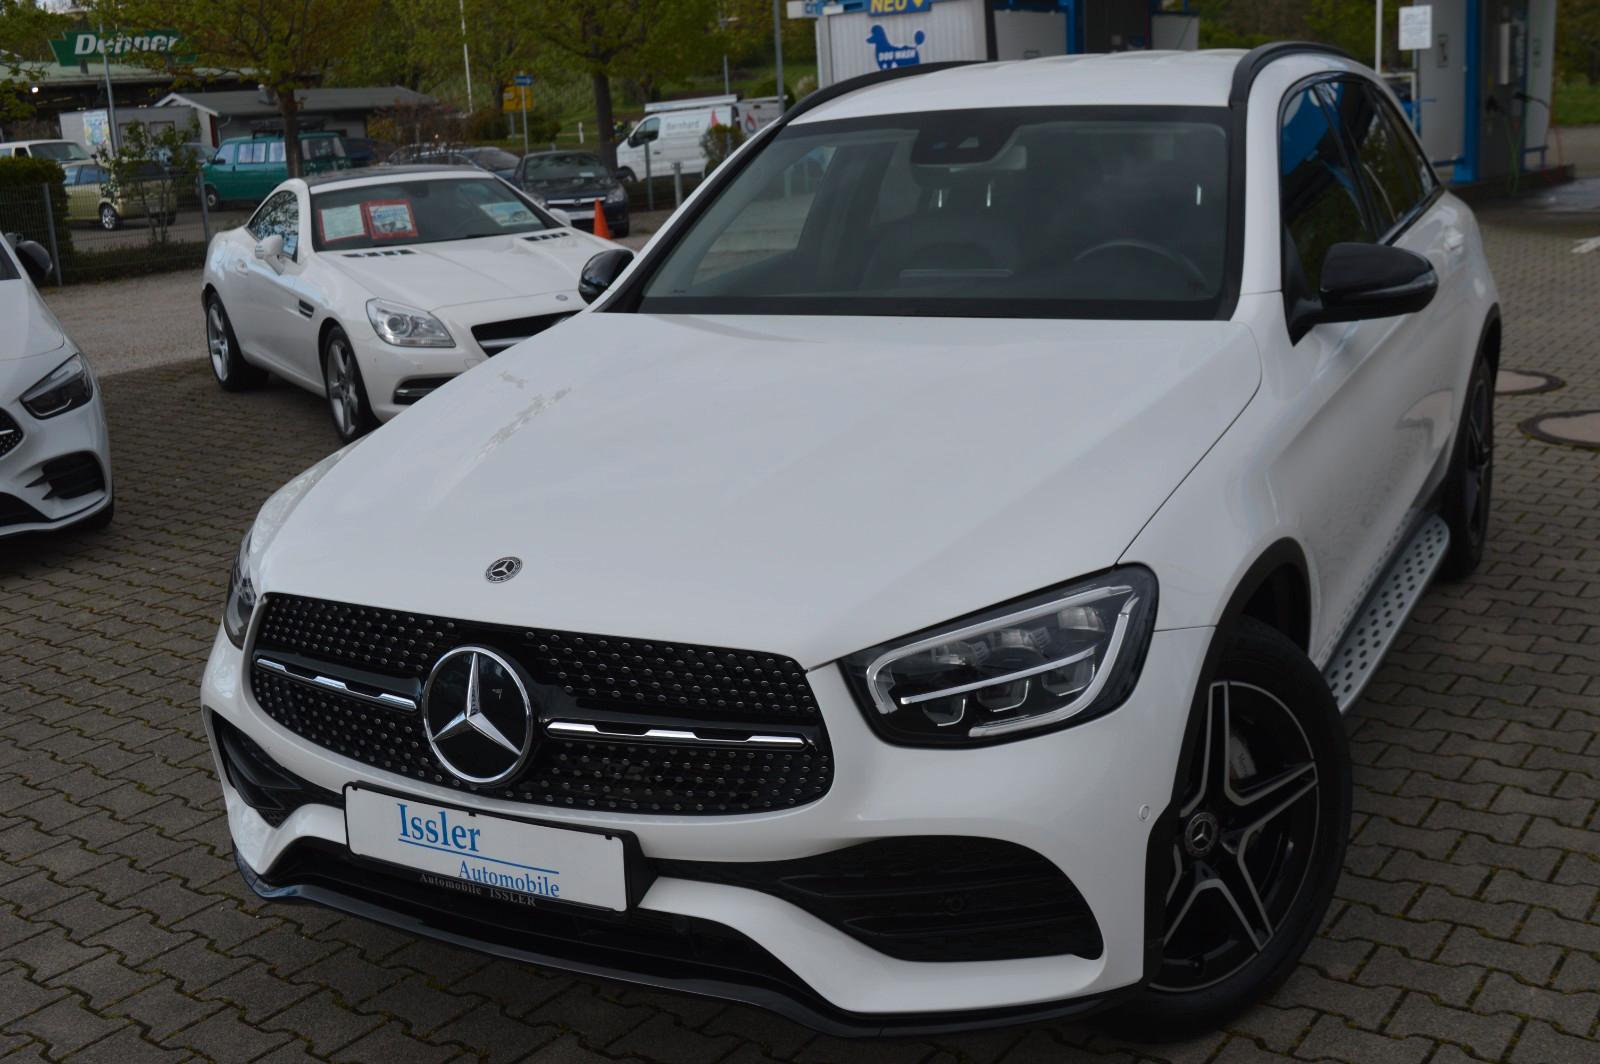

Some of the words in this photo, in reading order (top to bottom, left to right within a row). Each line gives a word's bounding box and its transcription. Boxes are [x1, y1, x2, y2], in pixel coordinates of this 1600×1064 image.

[870, 0, 907, 14] NEU
[398, 803, 480, 852] Issler
[420, 873, 481, 895] Automobile
[489, 888, 536, 907] ISSLER
[459, 860, 560, 897] Automobile
